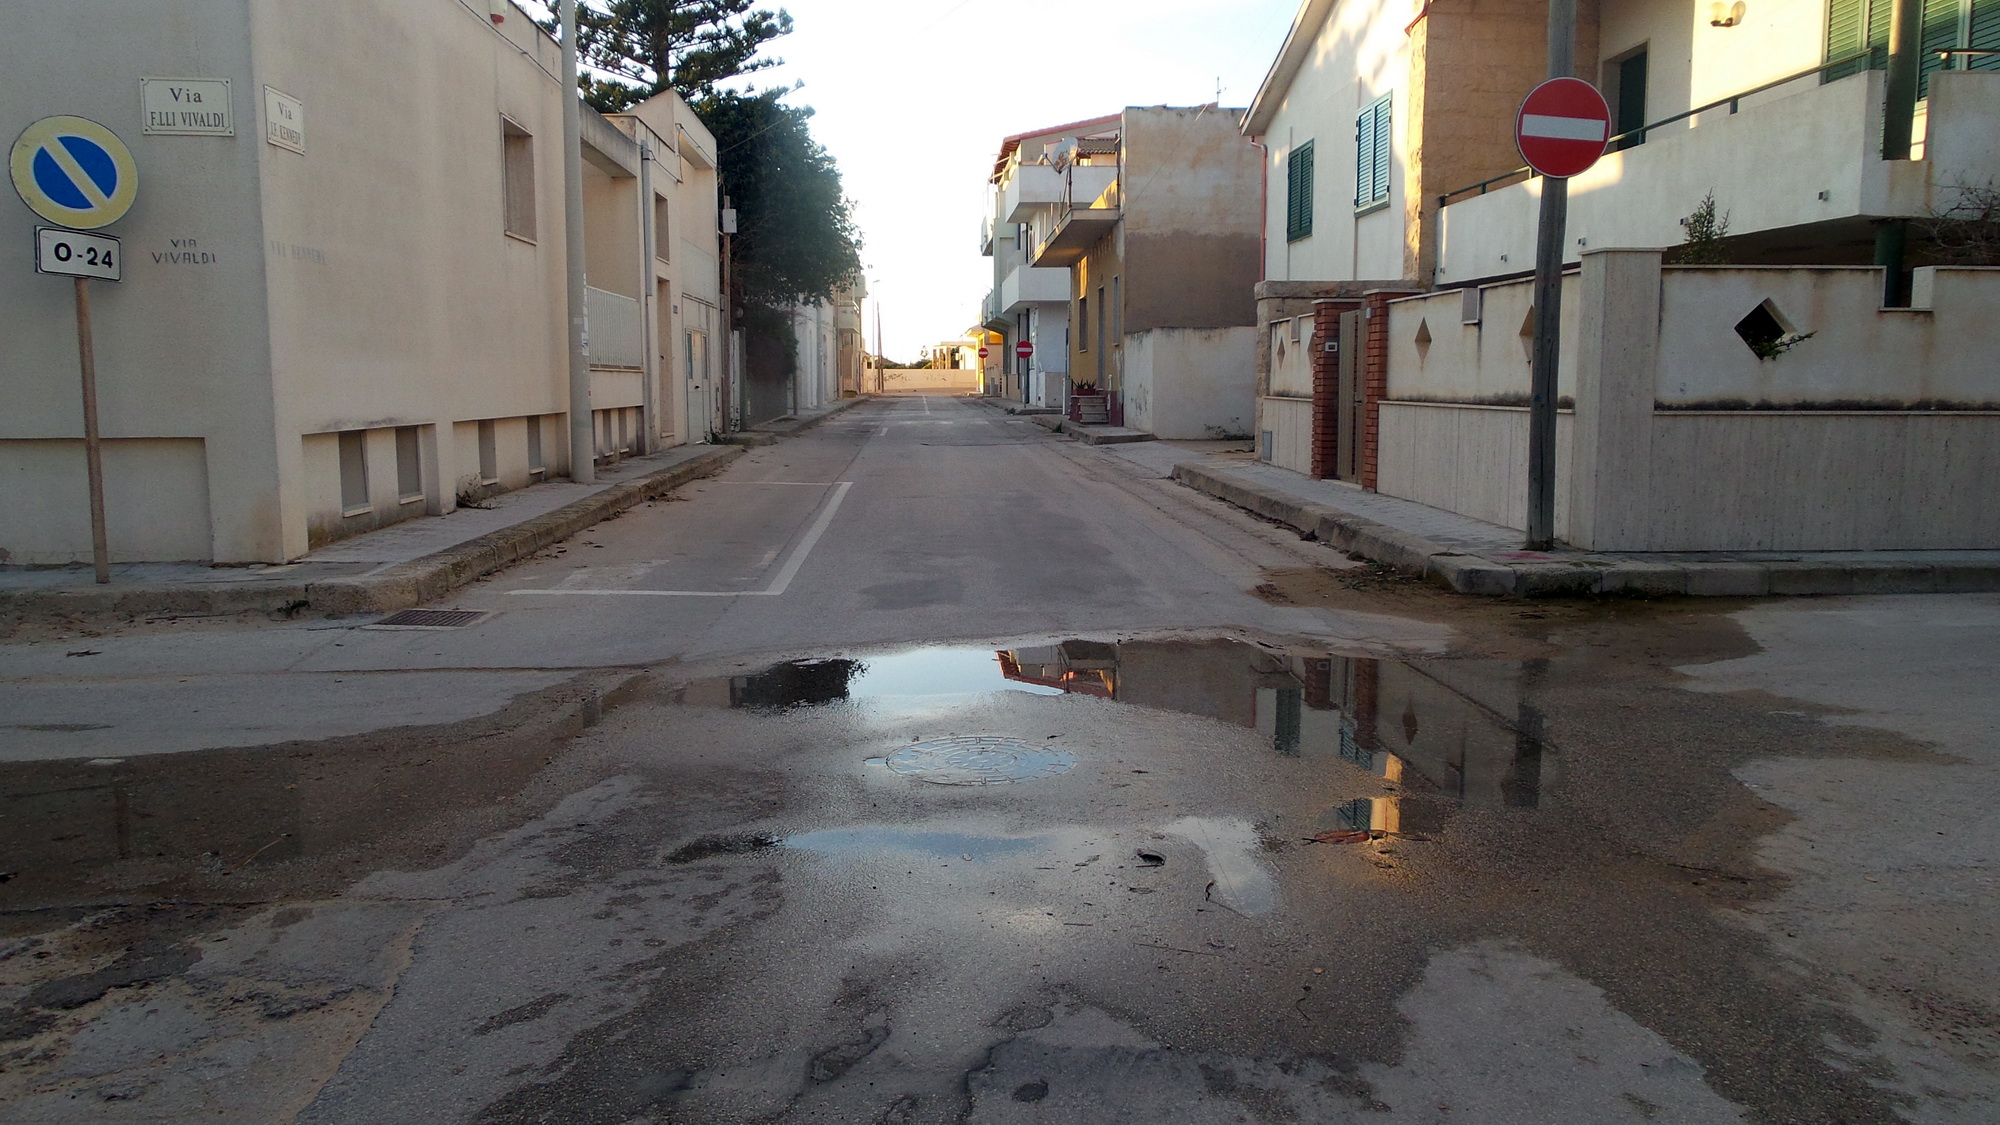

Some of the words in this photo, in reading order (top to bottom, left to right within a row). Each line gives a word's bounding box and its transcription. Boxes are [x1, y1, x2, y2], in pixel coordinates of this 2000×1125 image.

[169, 88, 202, 103] Via
[277, 101, 293, 120] Via
[150, 111, 176, 127] F.LLI
[181, 112, 225, 128] VIVALDI
[170, 239, 197, 248] VIA
[151, 251, 216, 264] VIVALDI
